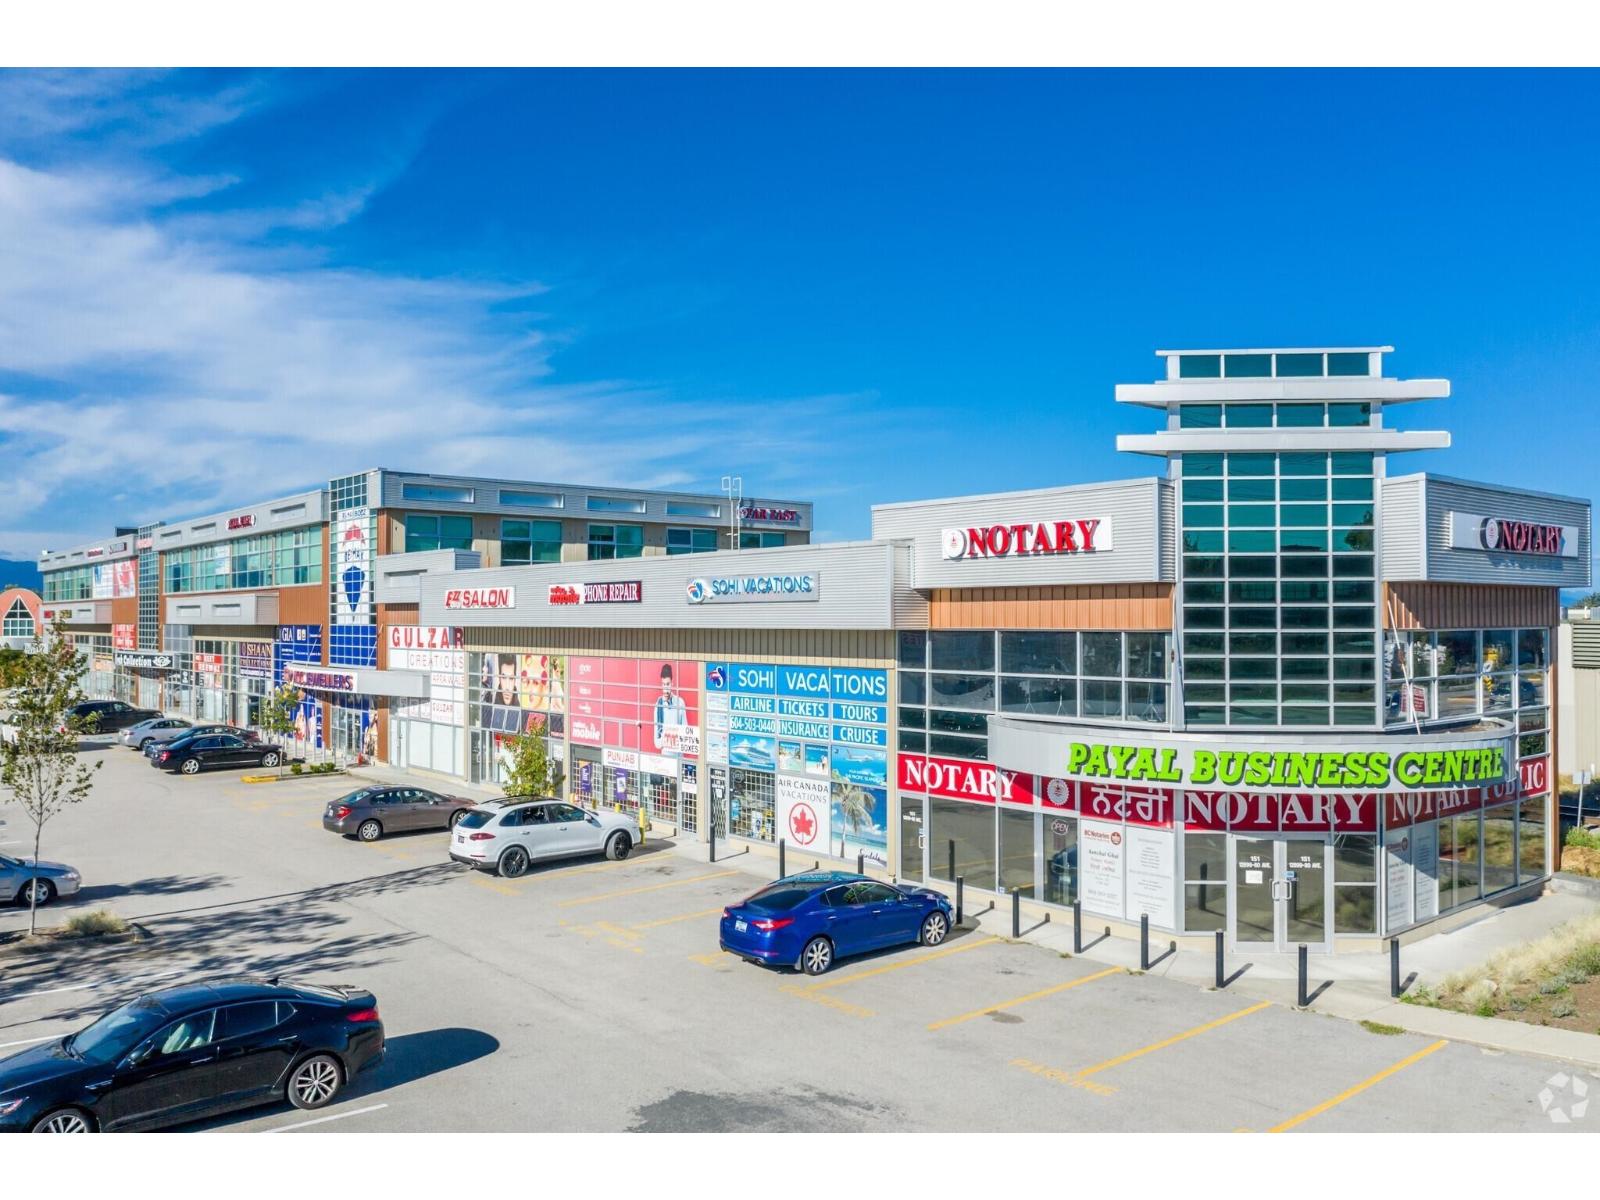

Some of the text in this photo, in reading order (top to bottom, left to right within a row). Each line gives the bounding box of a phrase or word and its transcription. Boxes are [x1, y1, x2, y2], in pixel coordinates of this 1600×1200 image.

[967, 519, 1100, 558] NOTARY
[1501, 520, 1562, 553] NOTARY
[463, 588, 510, 607] SALON
[584, 583, 638, 602] PHONE REPAIR
[712, 576, 813, 595] SOHI VACATIONS
[392, 627, 465, 650] GULZAR
[738, 669, 886, 696] SOHI VACATIONS
[733, 697, 773, 713] AIRLINE
[783, 701, 825, 718] TICKETS
[841, 705, 879, 722] TOURS
[685, 726, 694, 735] ON
[730, 716, 879, 744] 604-503-0440 INSURANCE CRUISE
[607, 750, 635, 765] PUNJAB
[680, 744, 699, 753] BOXES
[1067, 742, 1507, 788] PAYAL BUSINESS CENTRE
[778, 779, 829, 793] AIR CANADA
[905, 759, 1018, 801] NOTARY
[781, 788, 828, 804] VACATIONS
[1392, 787, 1471, 822] NOTARY
[1185, 792, 1368, 825] NOTARY
